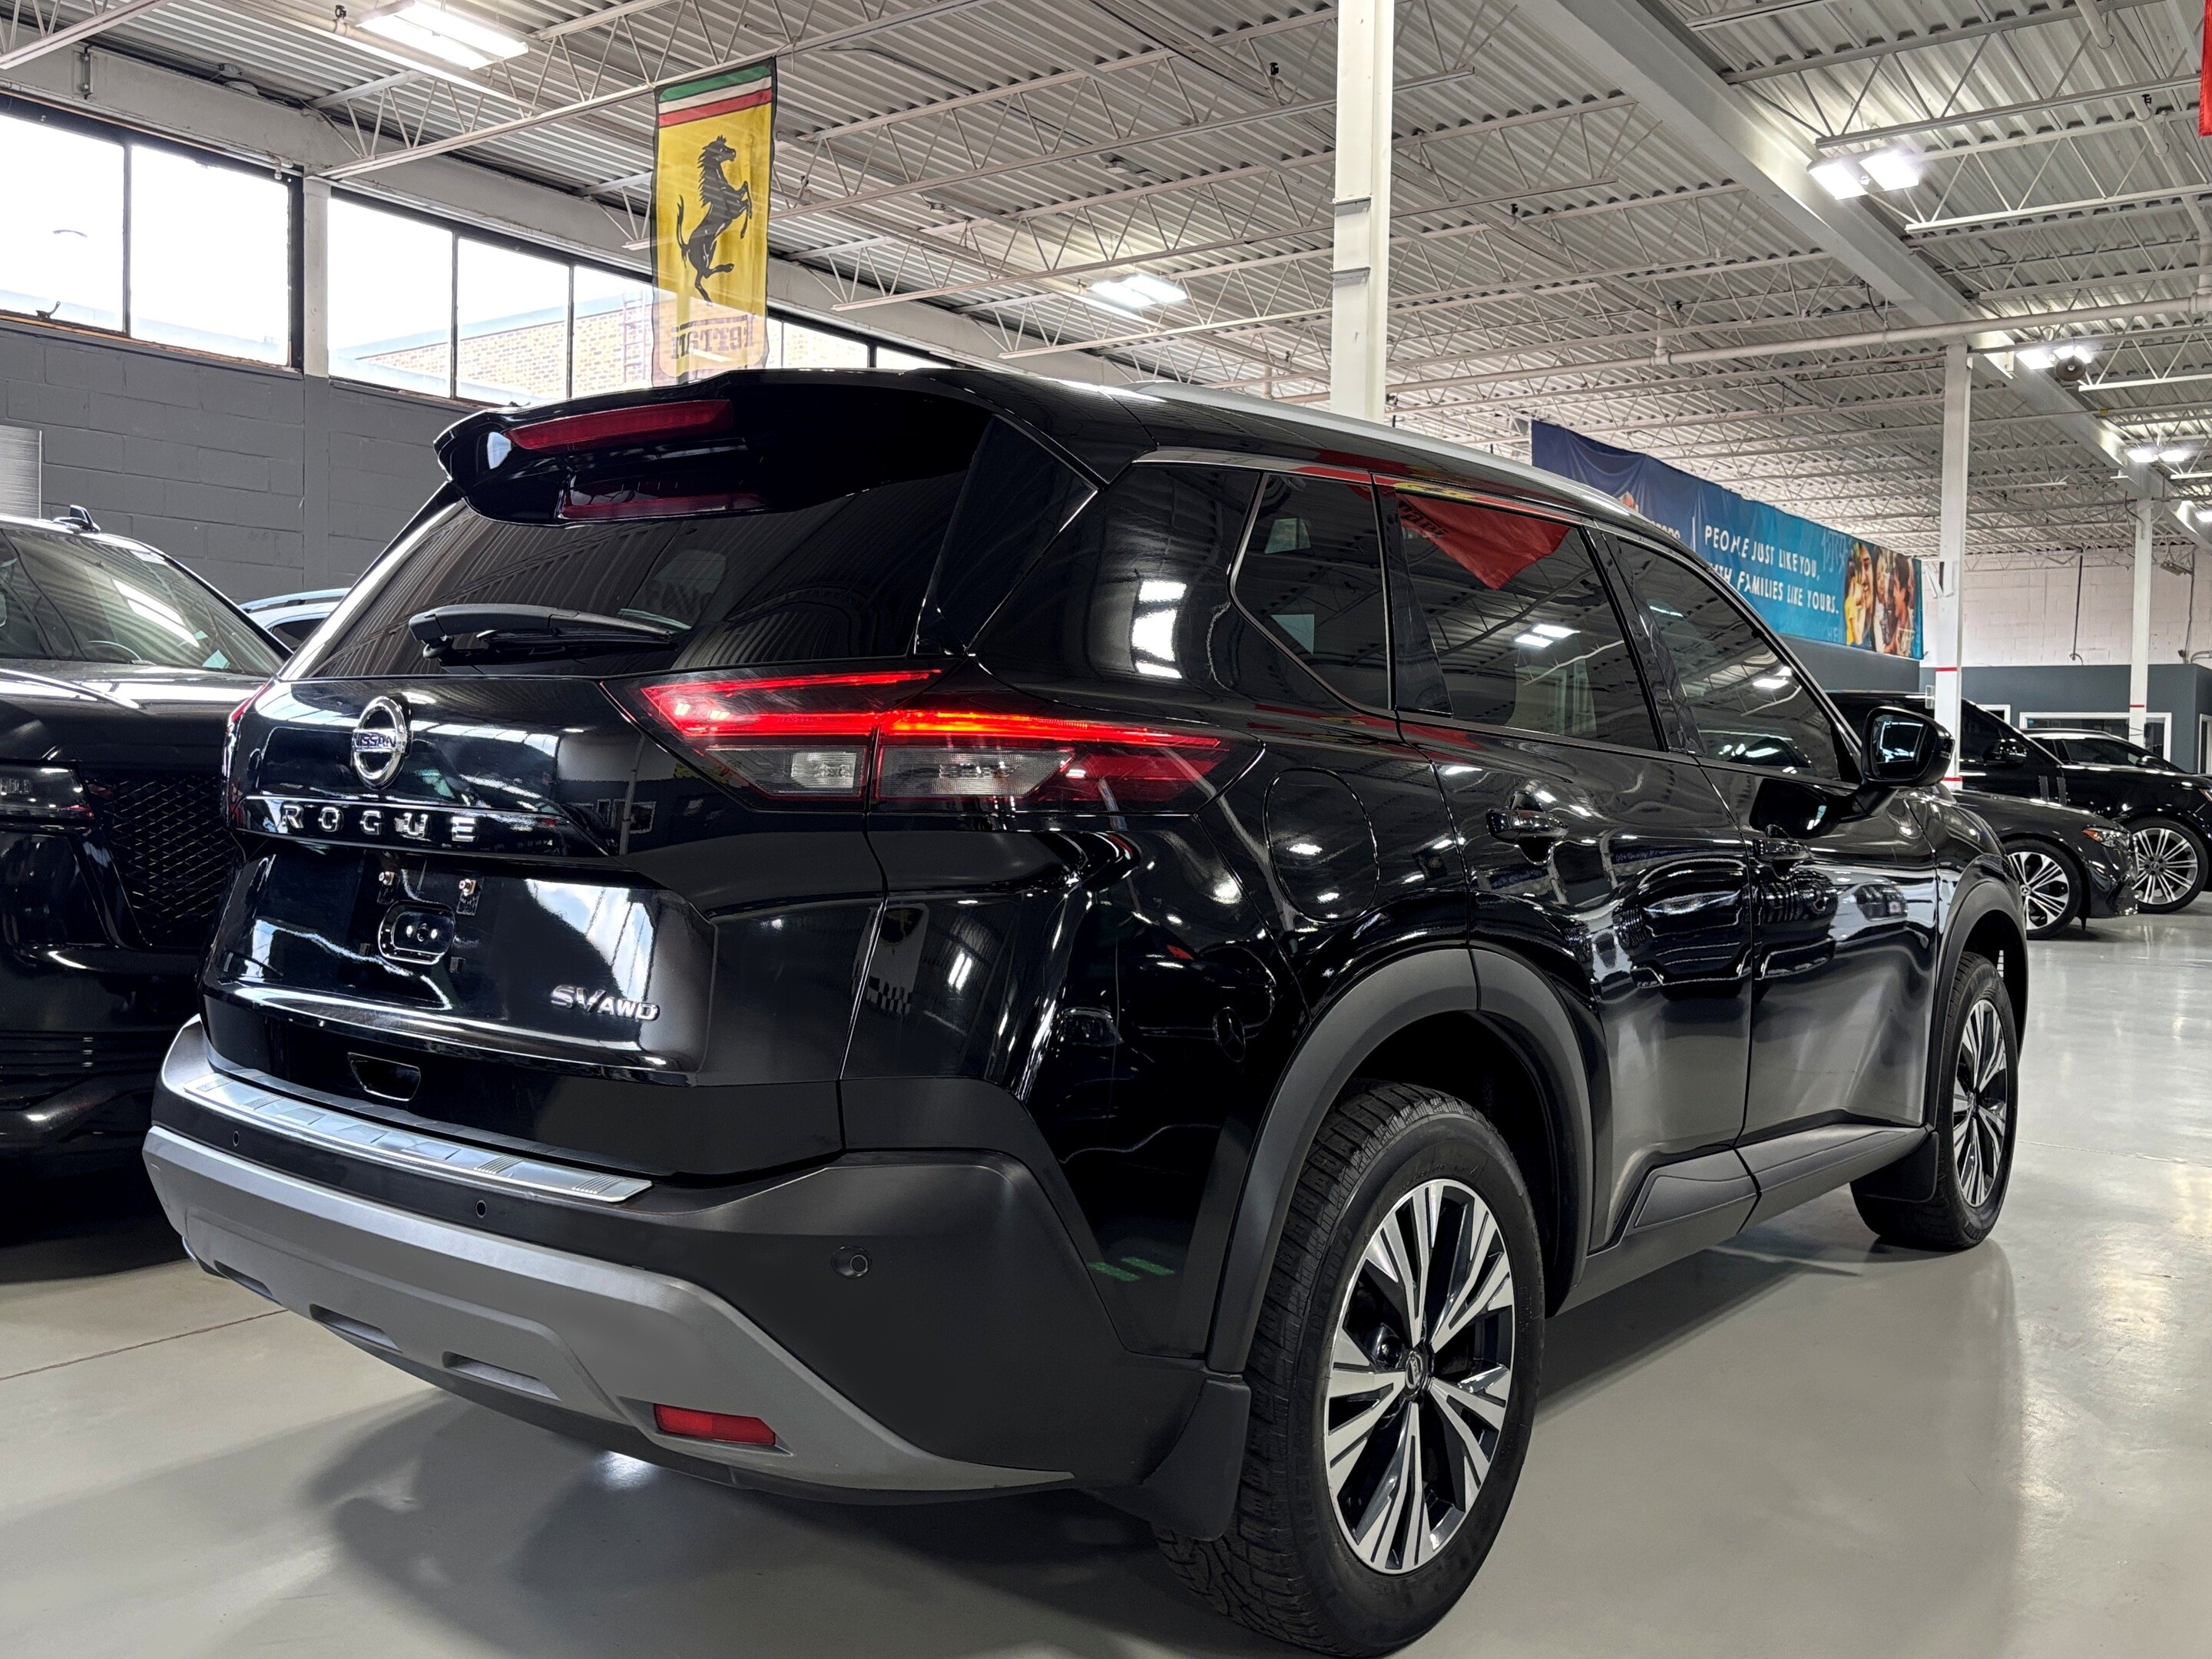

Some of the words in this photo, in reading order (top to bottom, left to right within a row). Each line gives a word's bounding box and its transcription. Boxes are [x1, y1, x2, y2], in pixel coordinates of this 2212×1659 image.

[1750, 541, 1775, 566] JUST
[1779, 548, 1798, 572] LIKE
[1799, 555, 1820, 581] YOU,
[1737, 571, 1784, 602] FAMILIES
[1786, 584, 1803, 606] LIKE
[1807, 589, 1839, 614] YOURS.
[282, 804, 479, 843] ROGUE
[550, 985, 607, 1014] SV
[598, 997, 661, 1022] AWD
